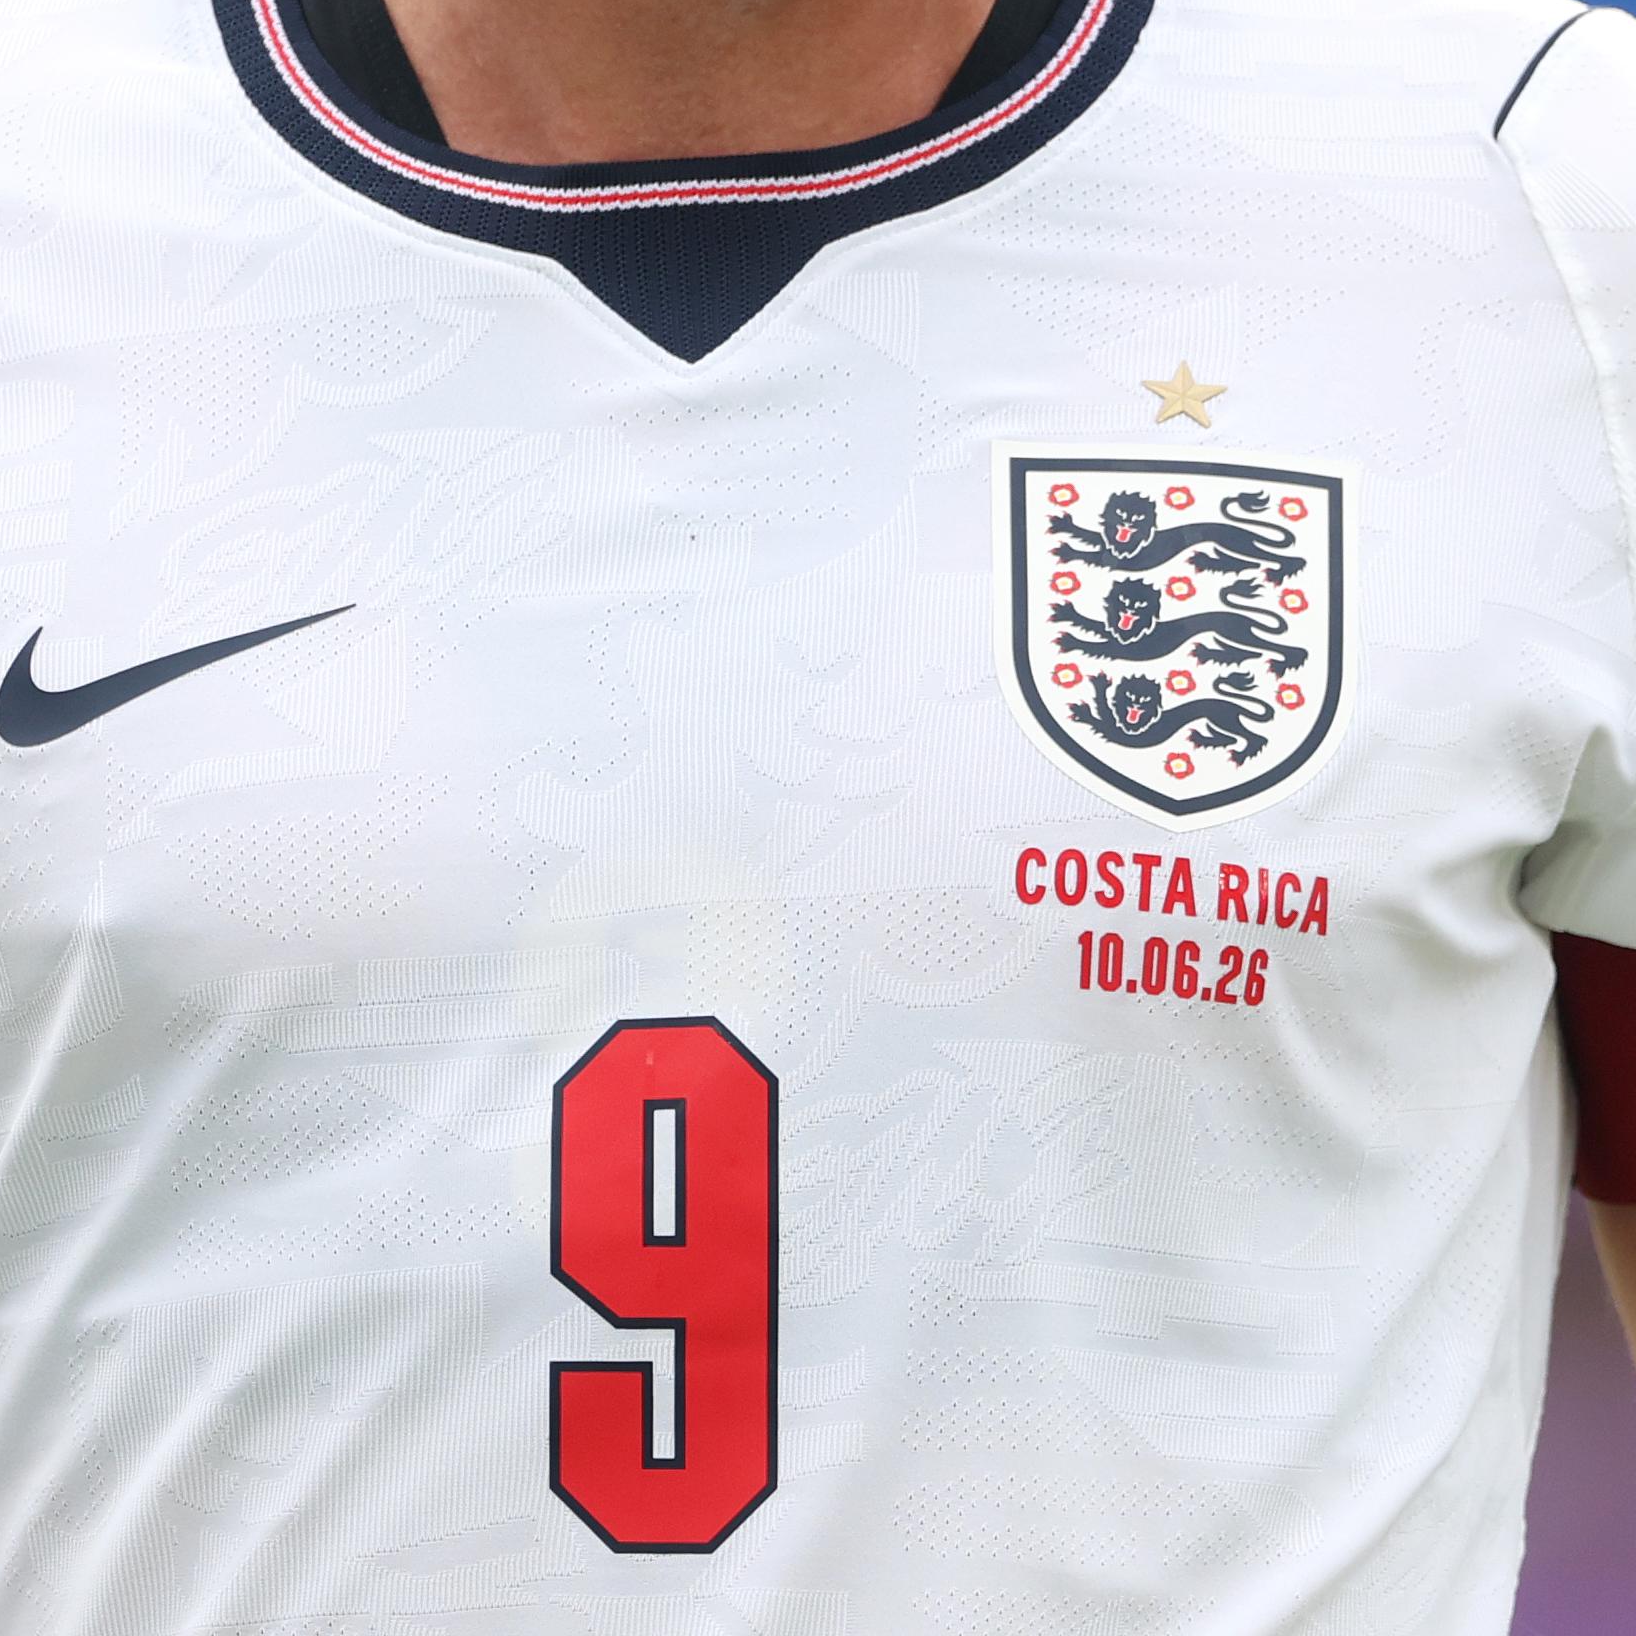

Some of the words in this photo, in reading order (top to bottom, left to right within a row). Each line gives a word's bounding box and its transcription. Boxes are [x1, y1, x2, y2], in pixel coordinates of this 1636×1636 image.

[1015, 847, 1197, 917] COSTA
[1216, 862, 1330, 936] RICA
[1078, 930, 1269, 1007] 10.06.26
[549, 1015, 780, 1555] 9
